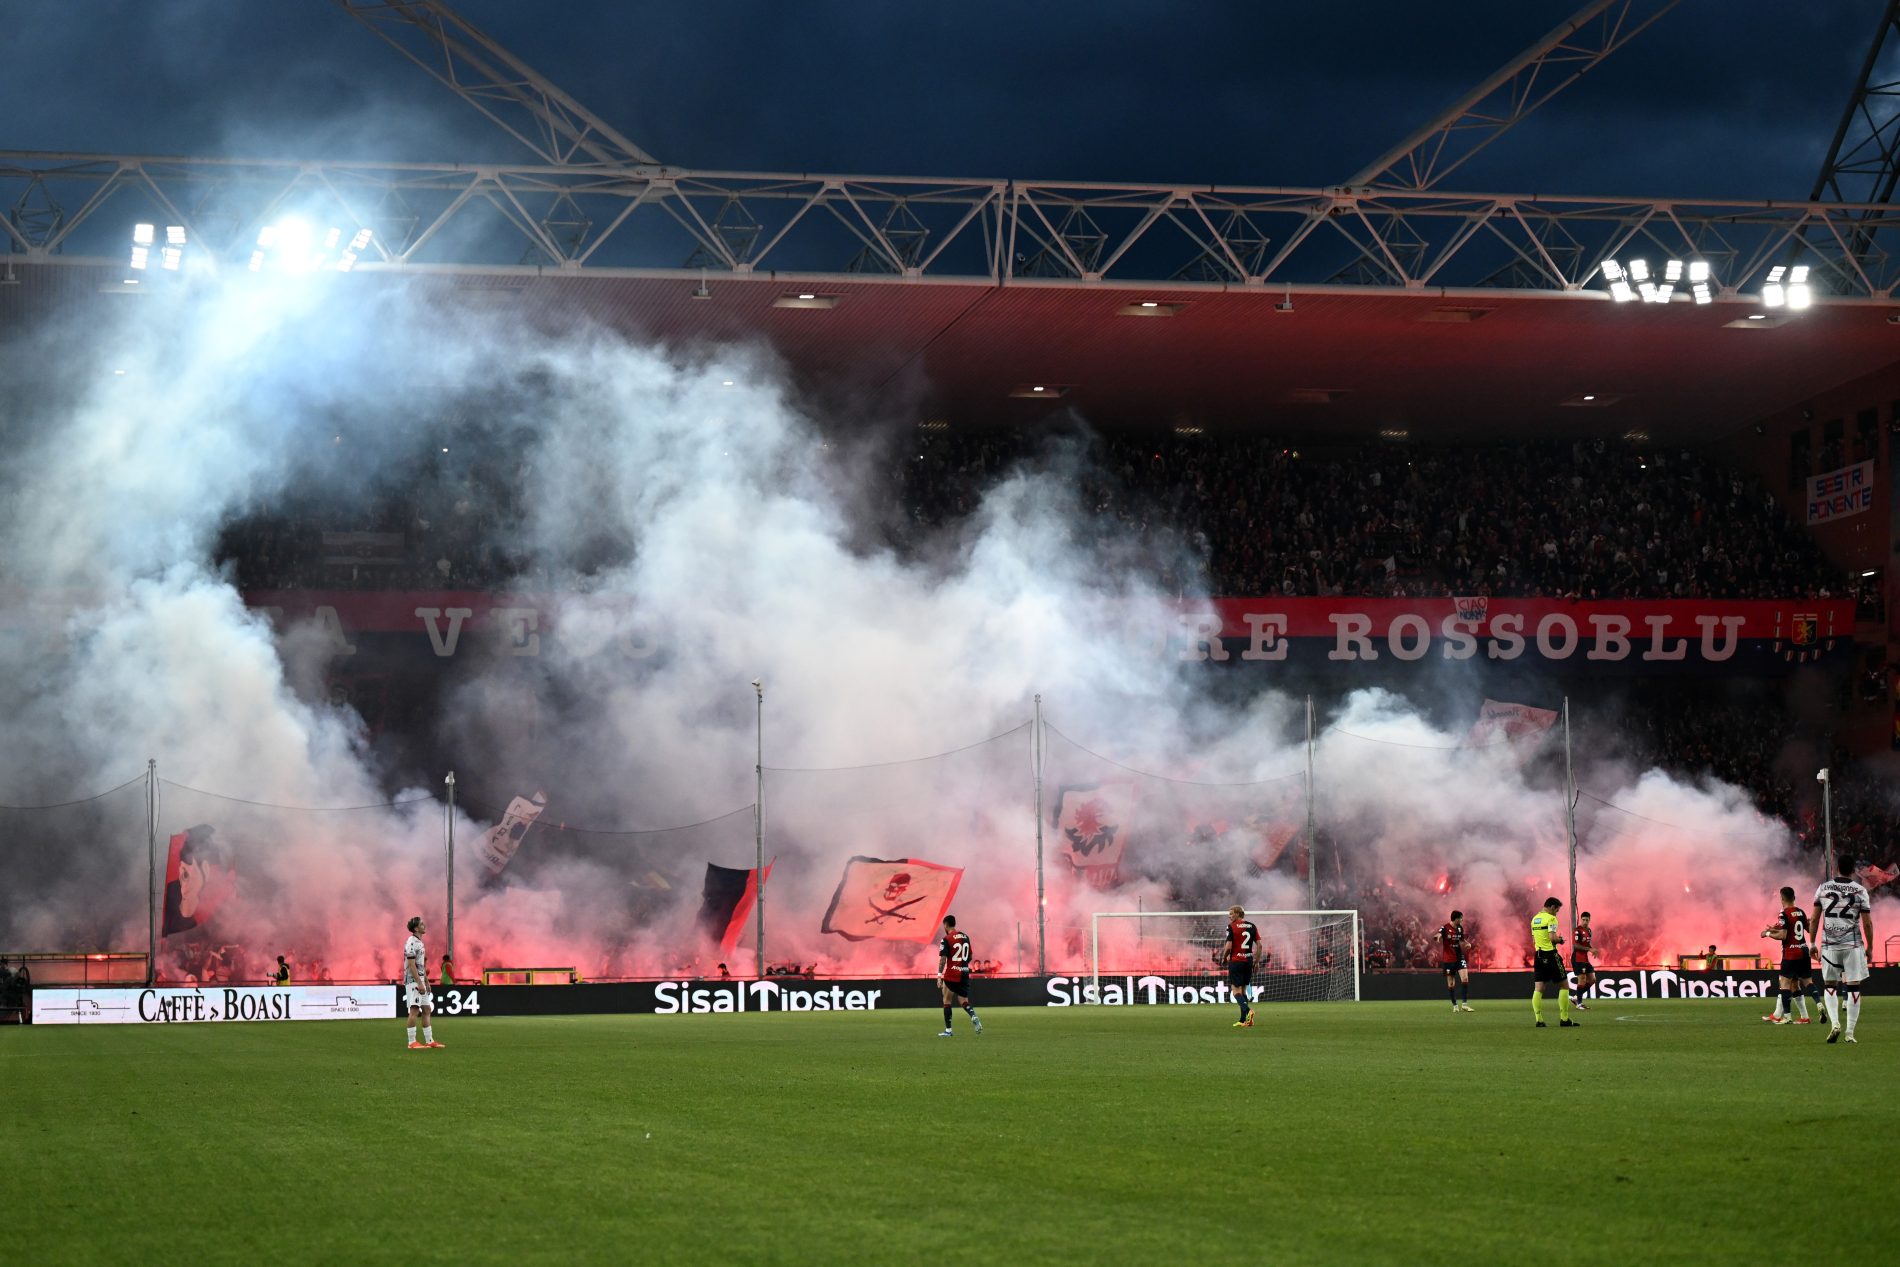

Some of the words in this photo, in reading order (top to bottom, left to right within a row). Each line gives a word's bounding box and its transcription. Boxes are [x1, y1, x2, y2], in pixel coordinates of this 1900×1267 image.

[1816, 464, 1864, 498] SESTRI
[1808, 486, 1872, 520] PONENTE
[1458, 597, 1486, 611] CIAO
[1327, 613, 1746, 662] ROSSOBLU
[1825, 892, 1856, 919] 22
[1240, 931, 1251, 949] 2
[1794, 920, 1804, 941] 9
[951, 942, 969, 962] 20
[654, 981, 745, 1014] Sisal
[749, 980, 882, 1012] Tipster
[1046, 976, 1134, 1007] Sisal
[1650, 970, 1772, 999] Tipster
[223, 988, 292, 1021] BOASI
